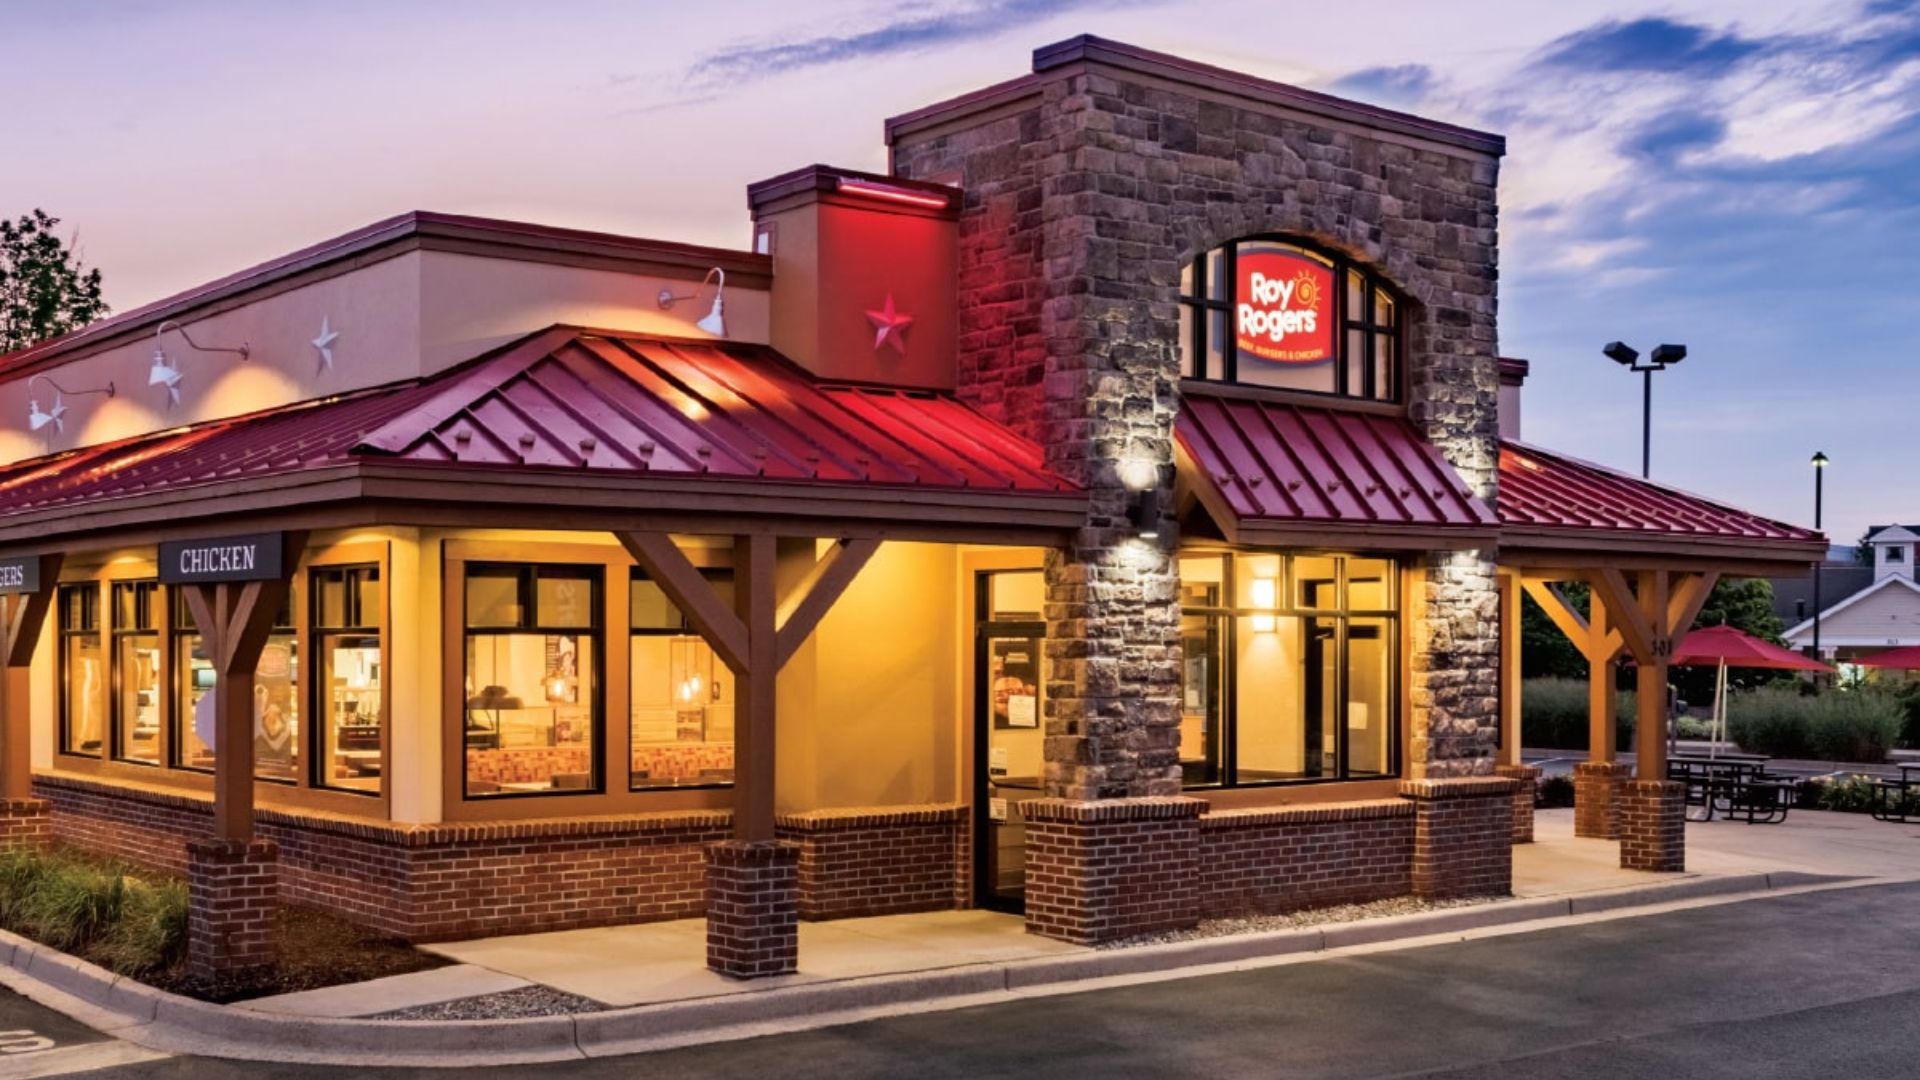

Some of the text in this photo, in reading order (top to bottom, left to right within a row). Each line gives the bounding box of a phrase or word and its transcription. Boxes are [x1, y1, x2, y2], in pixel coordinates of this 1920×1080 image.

[1250, 272, 1294, 310] Roy
[1239, 303, 1317, 342] Rogers
[180, 545, 256, 573] CHICKEN
